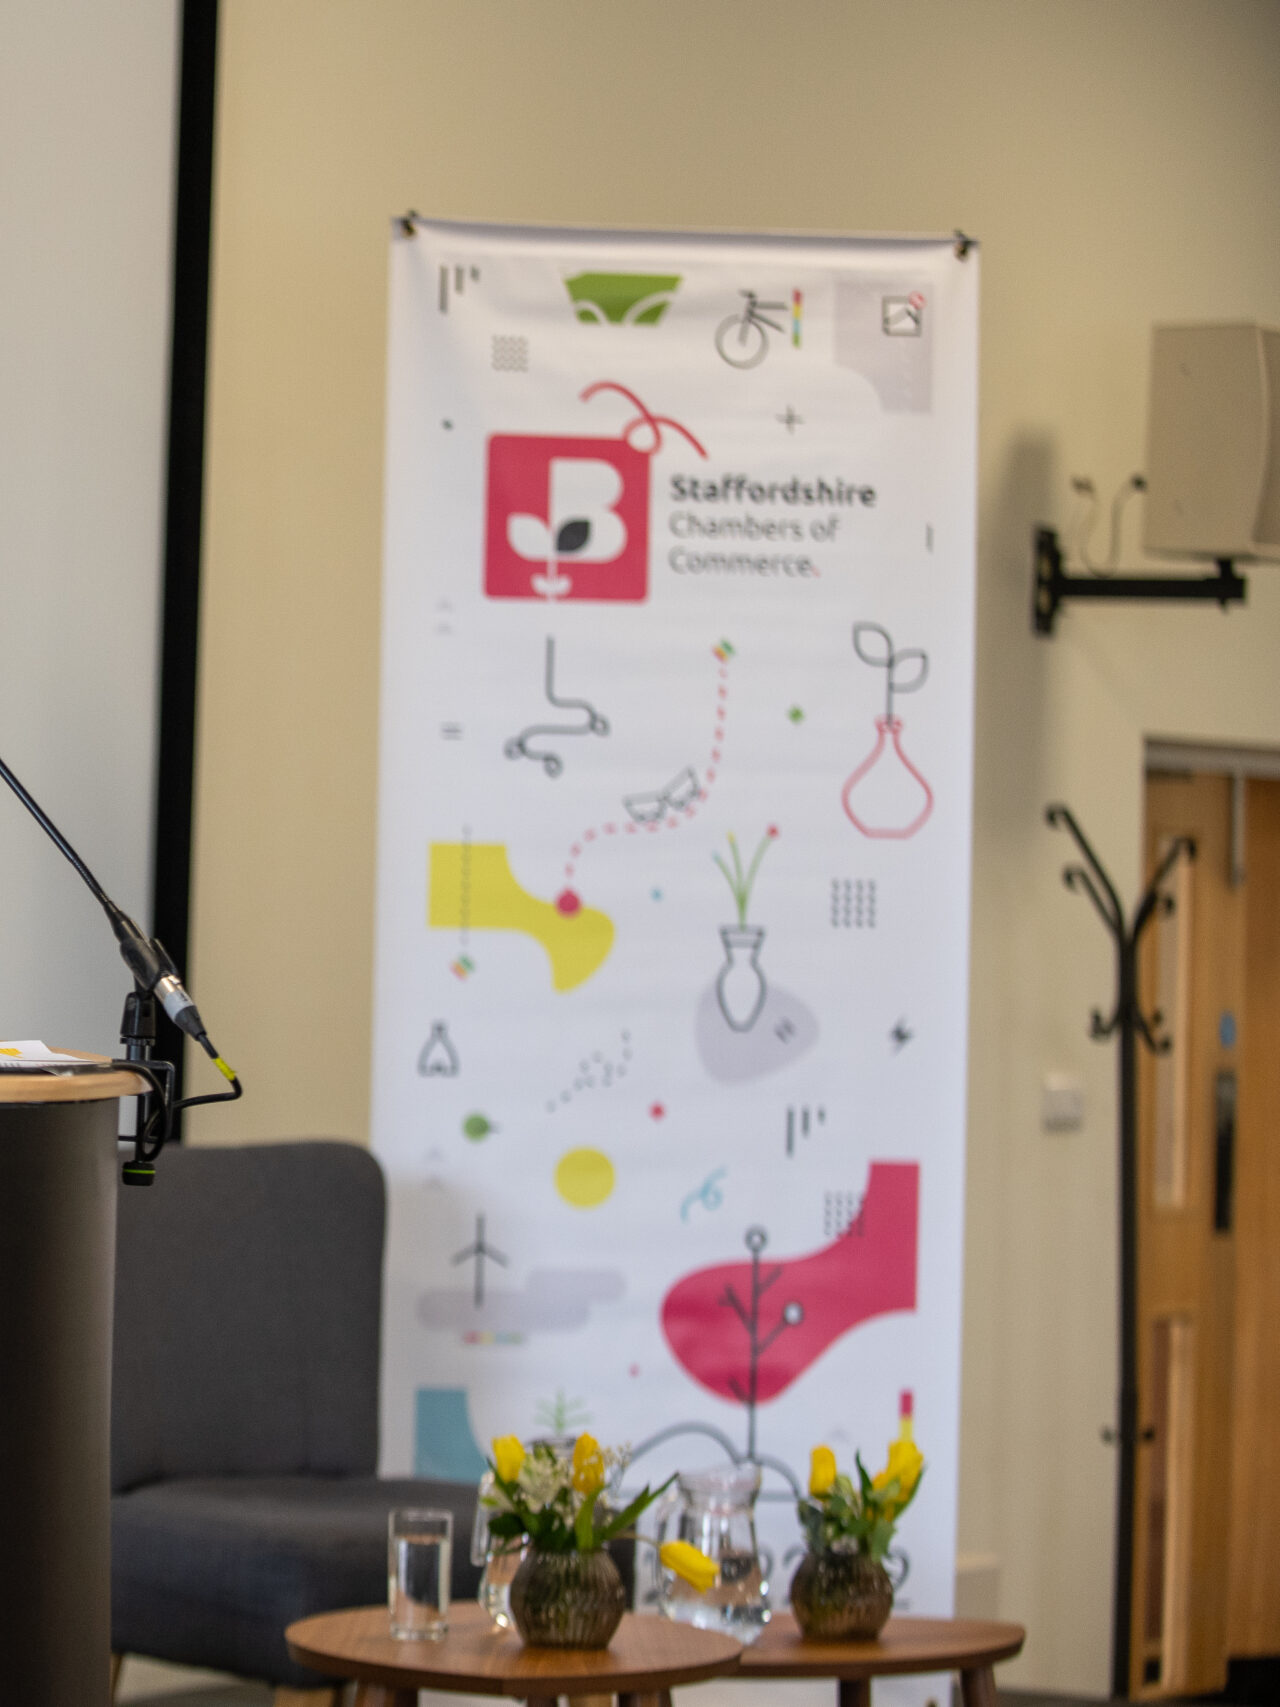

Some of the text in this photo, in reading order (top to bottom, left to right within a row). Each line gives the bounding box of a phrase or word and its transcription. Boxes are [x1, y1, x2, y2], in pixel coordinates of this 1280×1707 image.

[670, 473, 876, 507] Staffordshire
[669, 510, 840, 541] Chambers of
[669, 546, 821, 577] Commerce.
